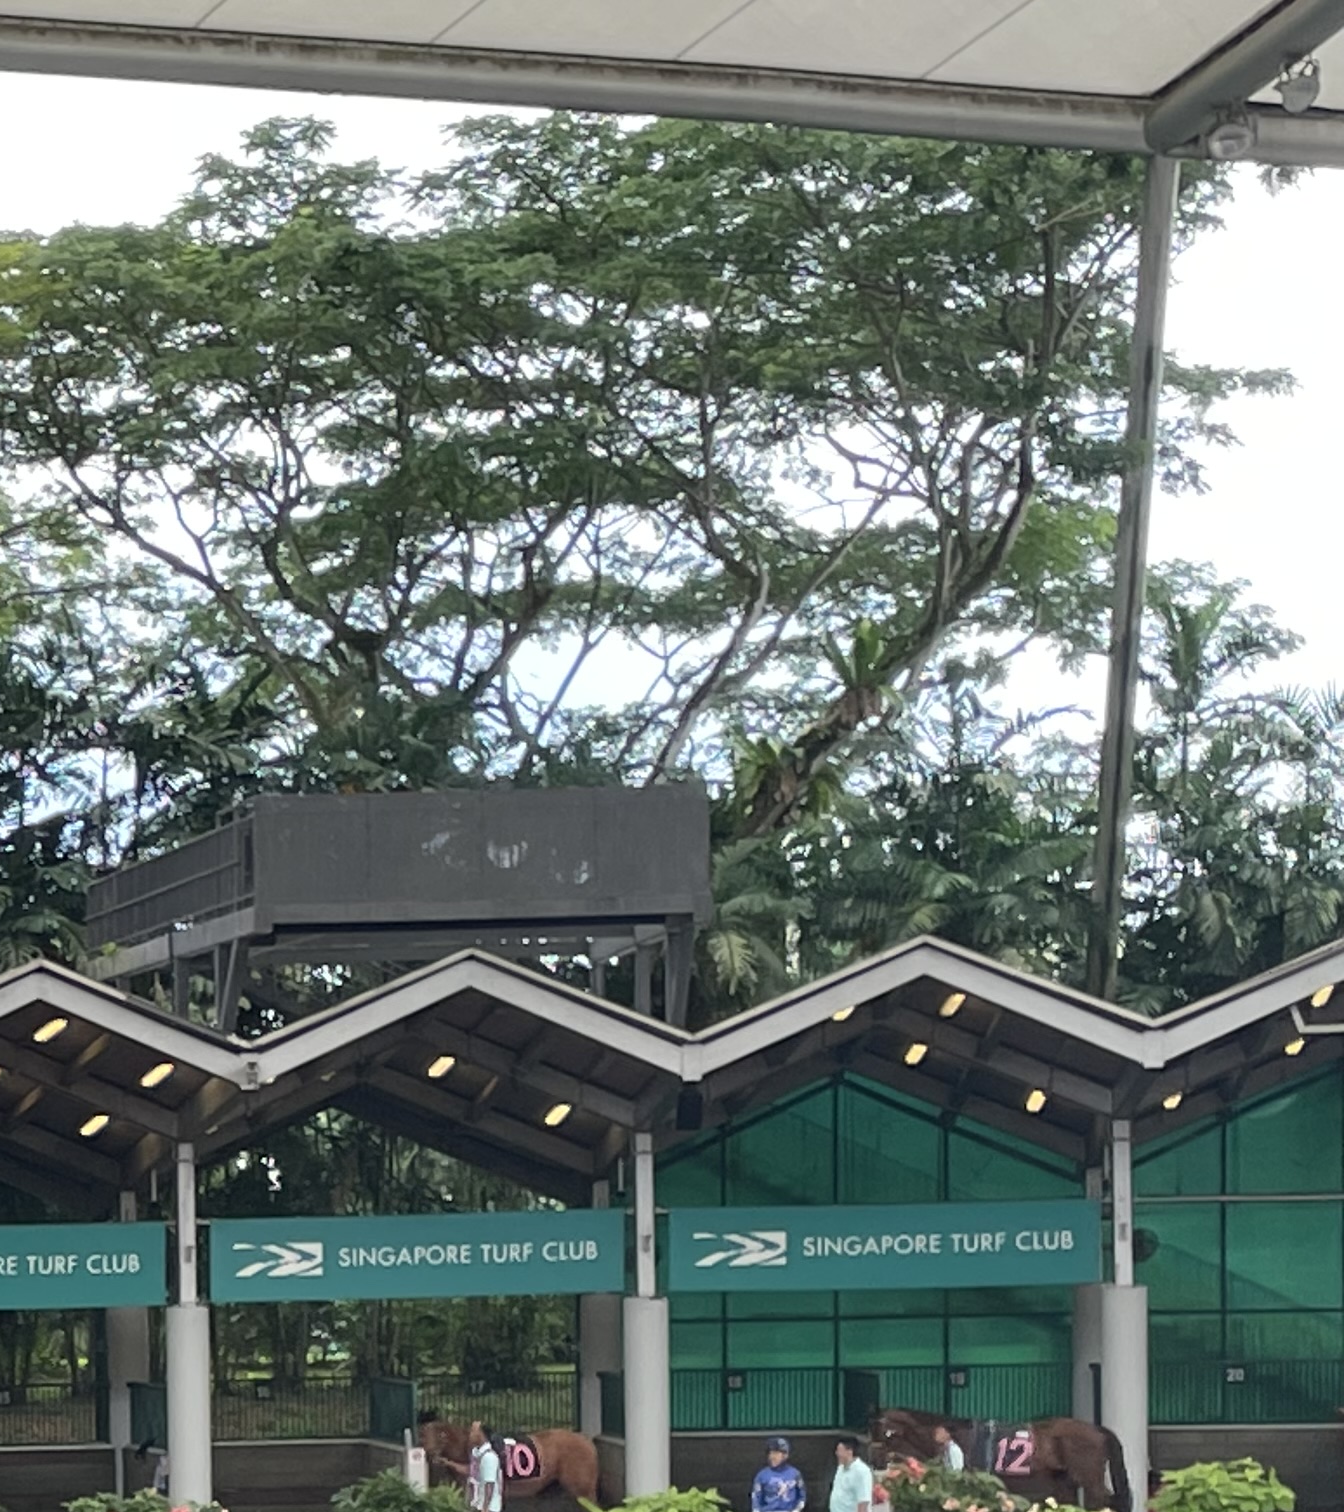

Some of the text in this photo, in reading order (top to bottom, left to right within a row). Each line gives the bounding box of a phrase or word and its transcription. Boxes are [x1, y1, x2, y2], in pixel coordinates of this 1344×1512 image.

[337, 1239, 599, 1269] SINGAPORE TURF CLUB
[802, 1229, 1075, 1258] SINGAPORE TURF CLUB
[25, 1253, 79, 1276] TURF
[85, 1252, 141, 1276] CLUB
[1226, 1368, 1245, 1382] 20
[505, 1442, 535, 1477] 10
[994, 1437, 1034, 1475] 12
